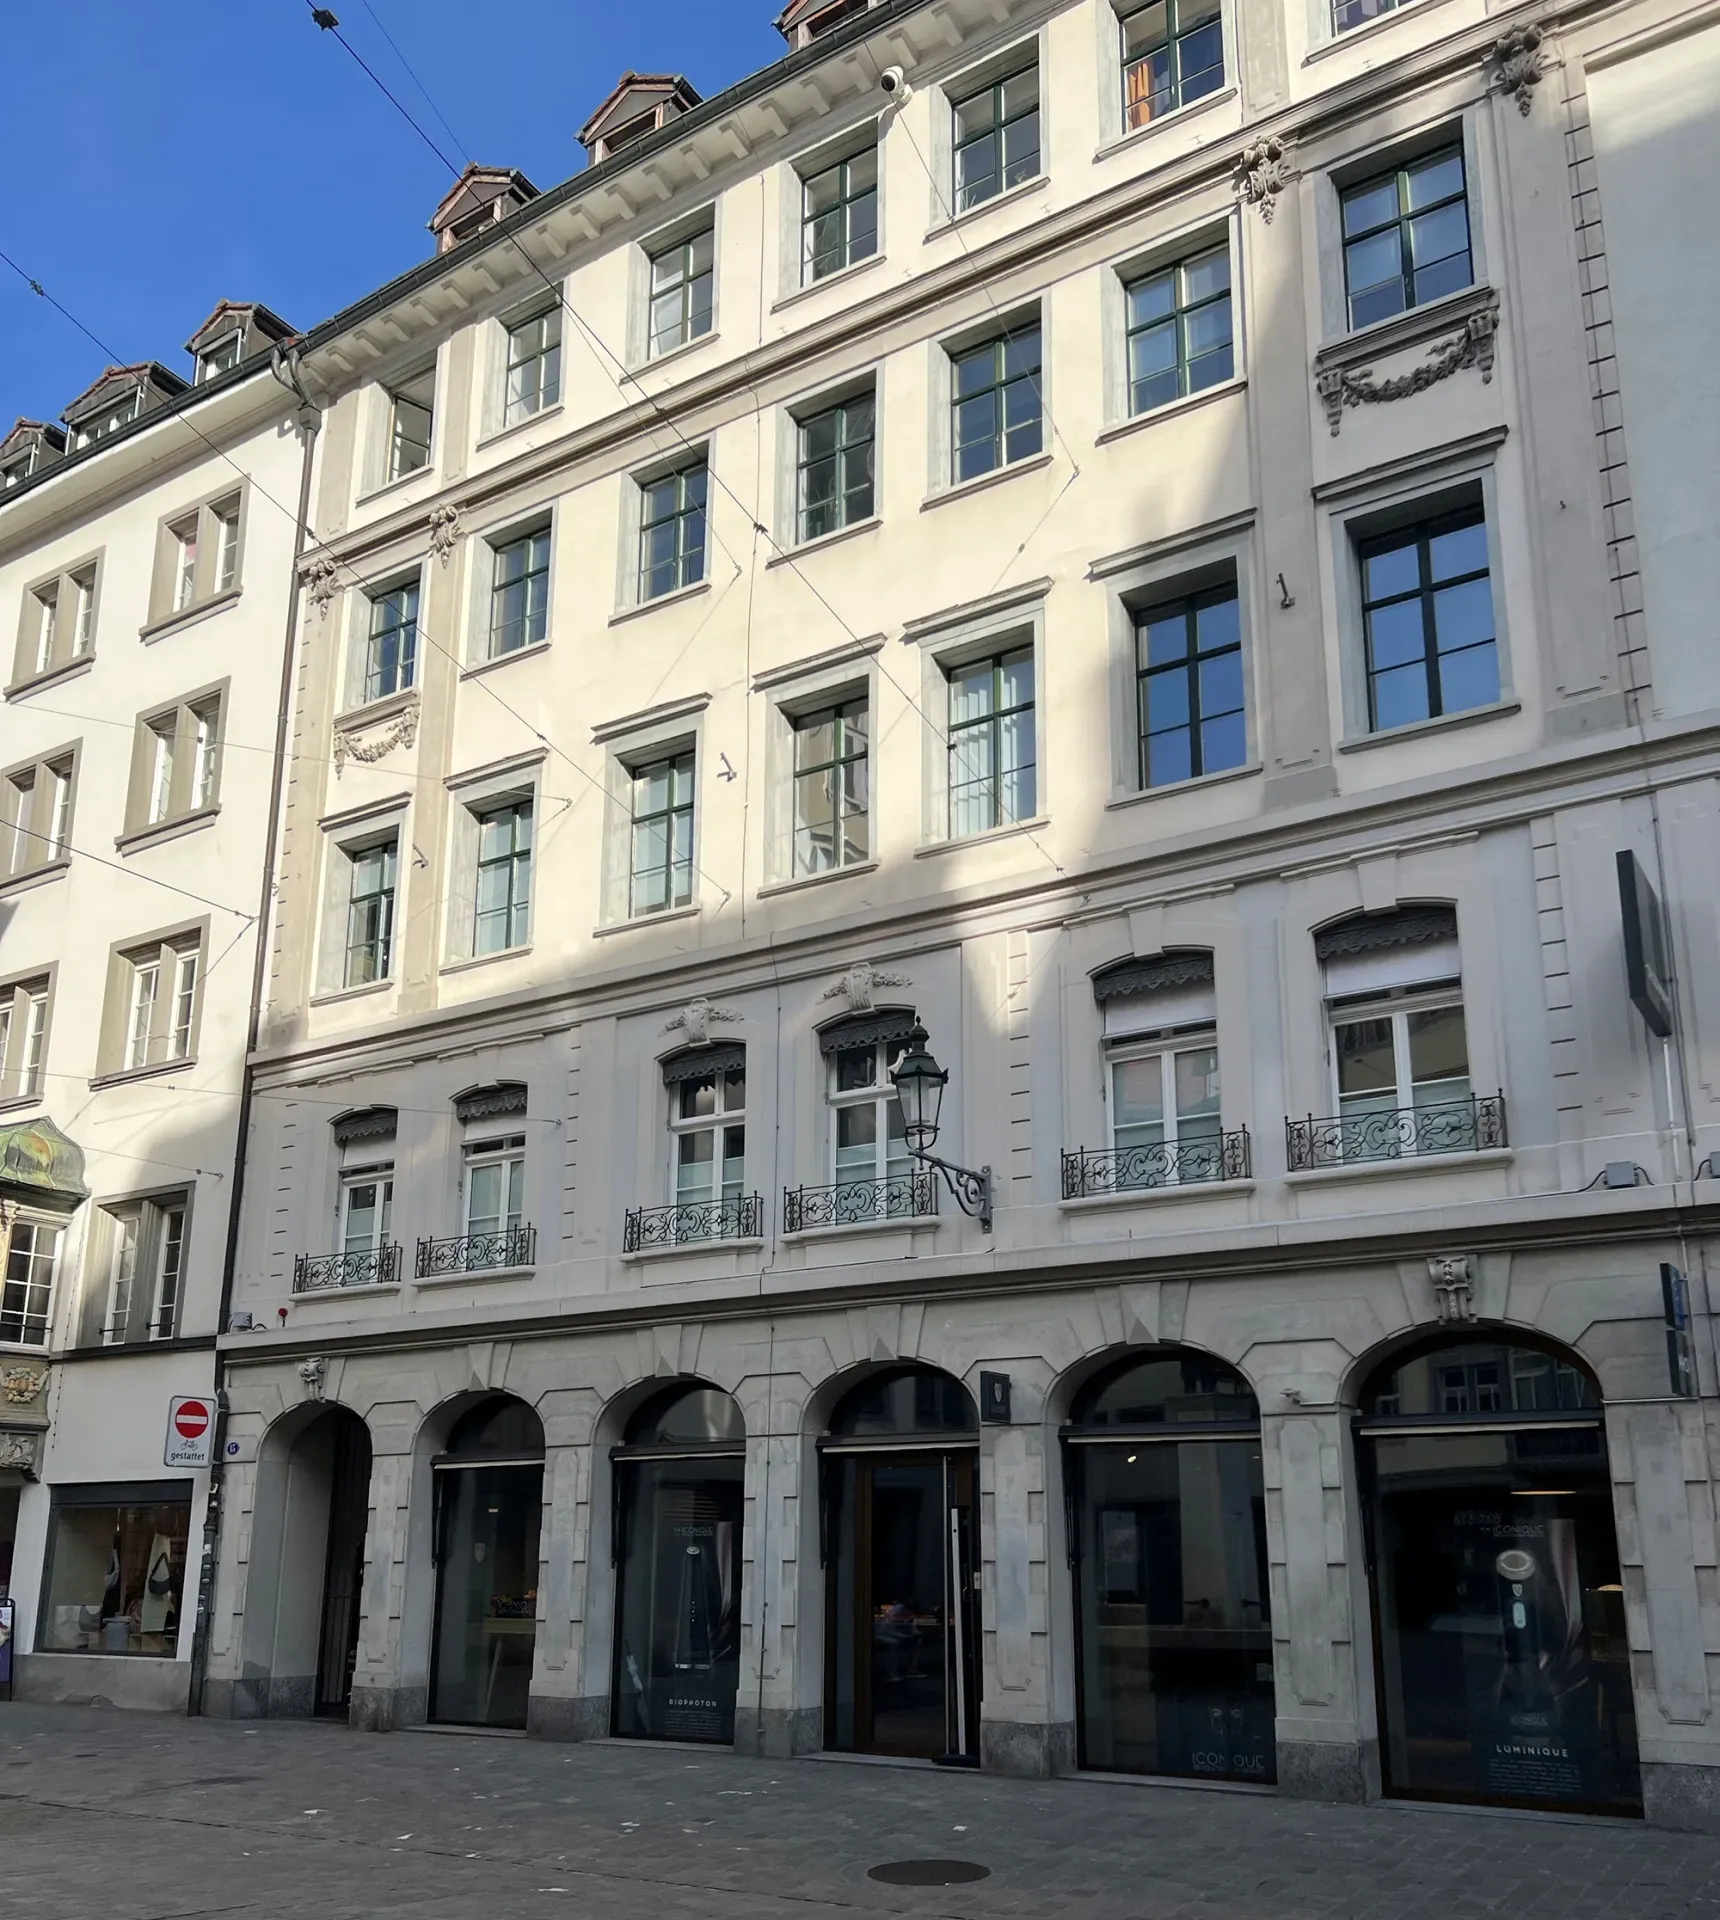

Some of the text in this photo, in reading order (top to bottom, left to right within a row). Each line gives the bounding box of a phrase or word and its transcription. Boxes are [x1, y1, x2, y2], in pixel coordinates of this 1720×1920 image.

[170, 1451, 205, 1462] gestattet
[668, 1698, 717, 1707] BIOPHOTON
[1495, 1744, 1569, 1759] LUMINIQUE
